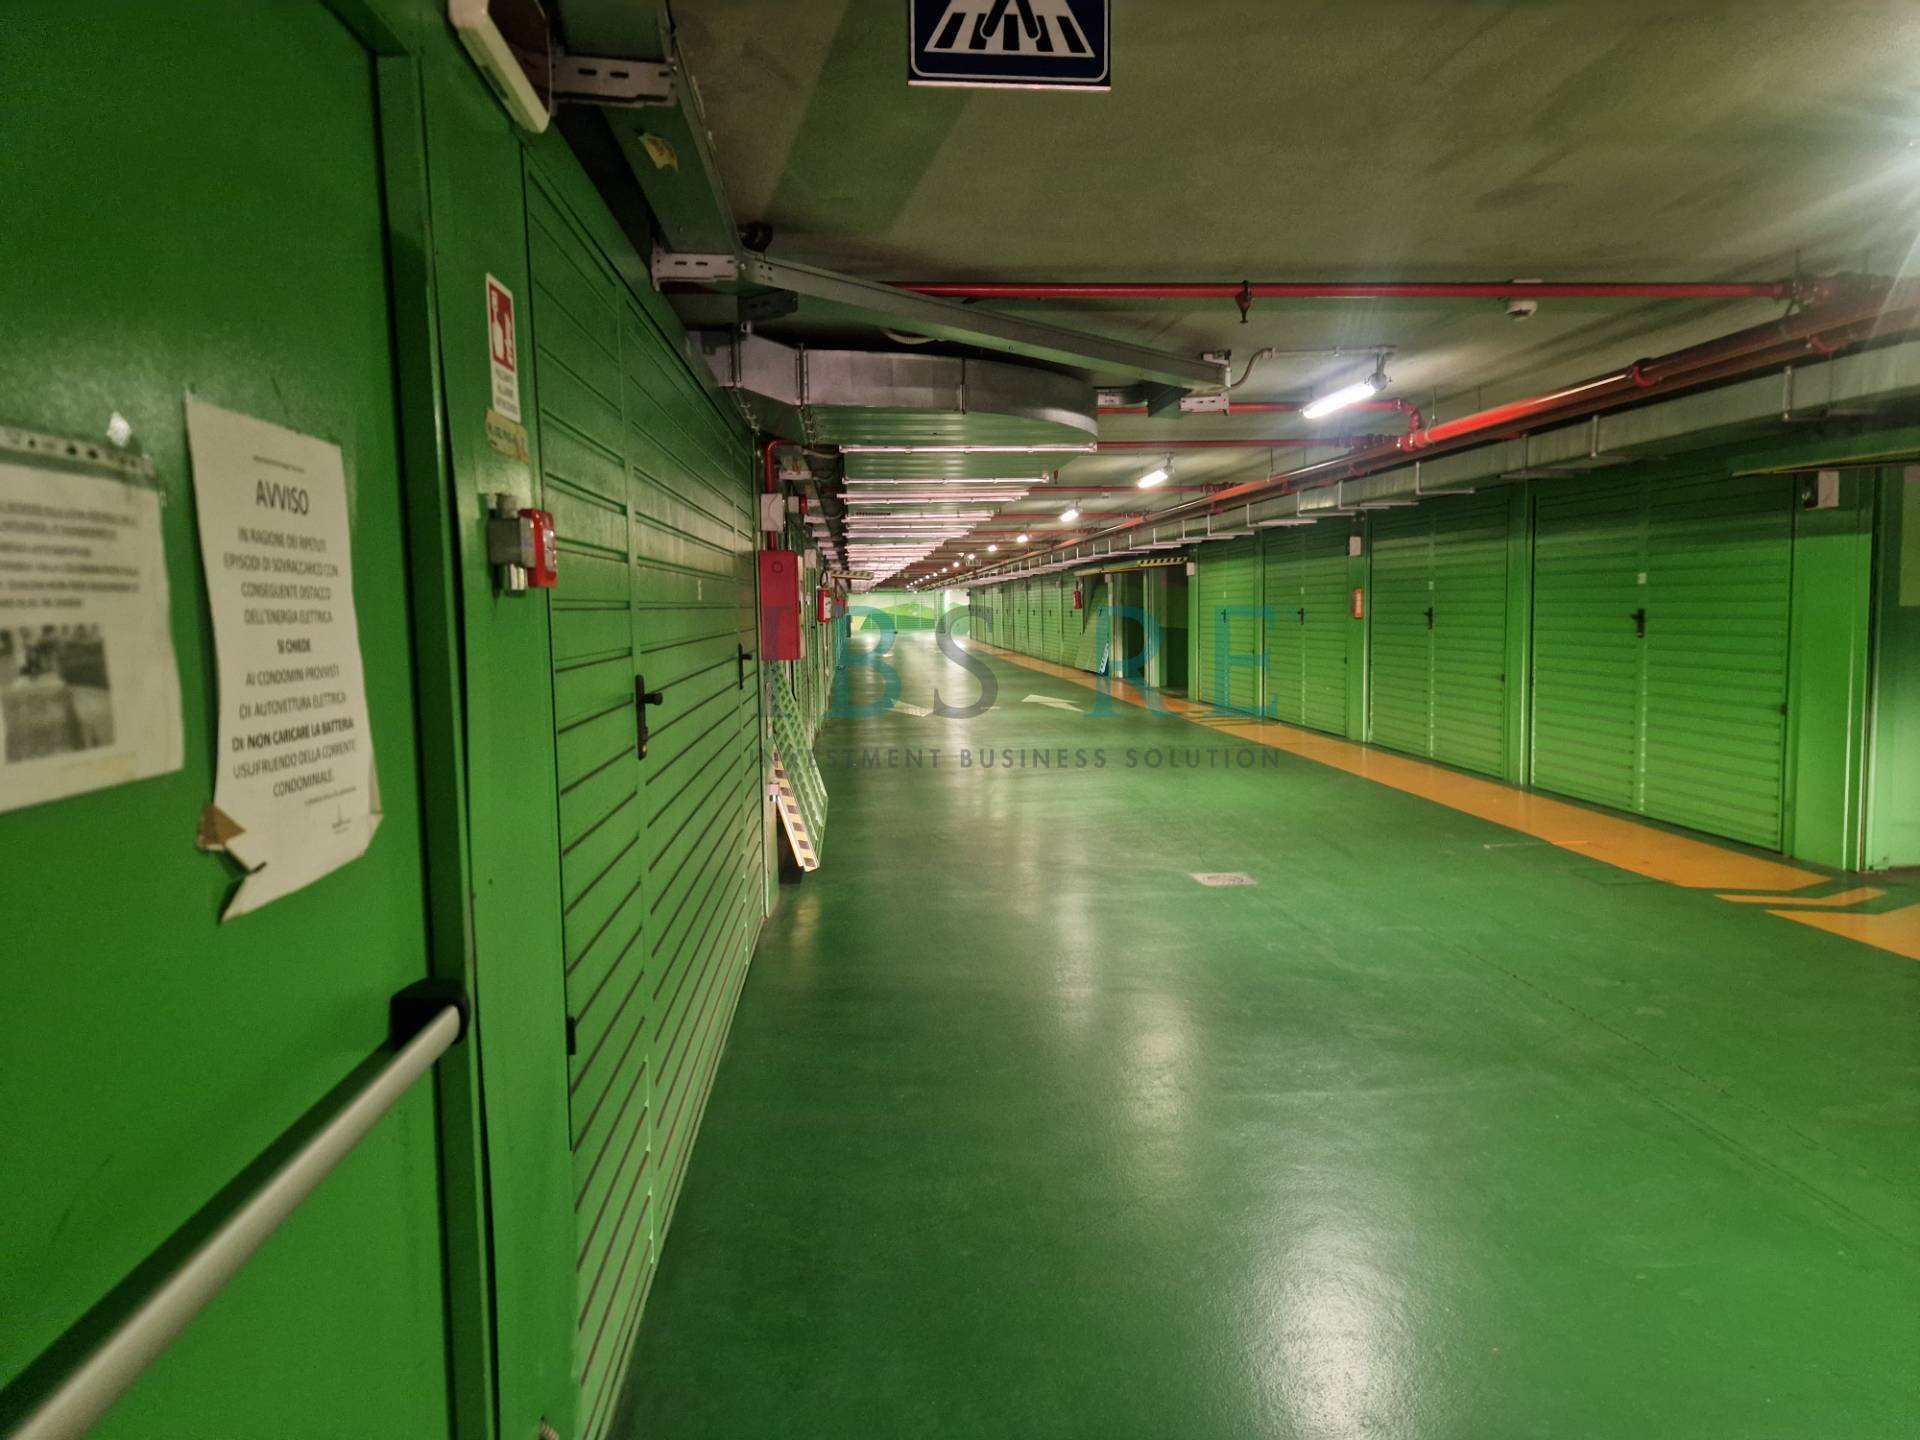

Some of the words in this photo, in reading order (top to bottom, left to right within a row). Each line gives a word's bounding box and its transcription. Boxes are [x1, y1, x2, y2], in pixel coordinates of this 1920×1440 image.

[255, 479, 310, 516] AVVISO
[241, 581, 298, 601] CONSEGUENTE
[286, 638, 311, 653] CHIEDE
[257, 668, 304, 687] CONDOMINI
[239, 703, 251, 721] DI
[254, 697, 312, 718] AUTOVETTURA
[232, 736, 244, 753] DI
[247, 732, 271, 749] NON
[272, 724, 311, 745] CARICARE
[311, 721, 321, 738] LA
[321, 717, 354, 736] BATTERIA
[232, 752, 297, 780] USUFRUENDO
[298, 746, 321, 767] DELLA
